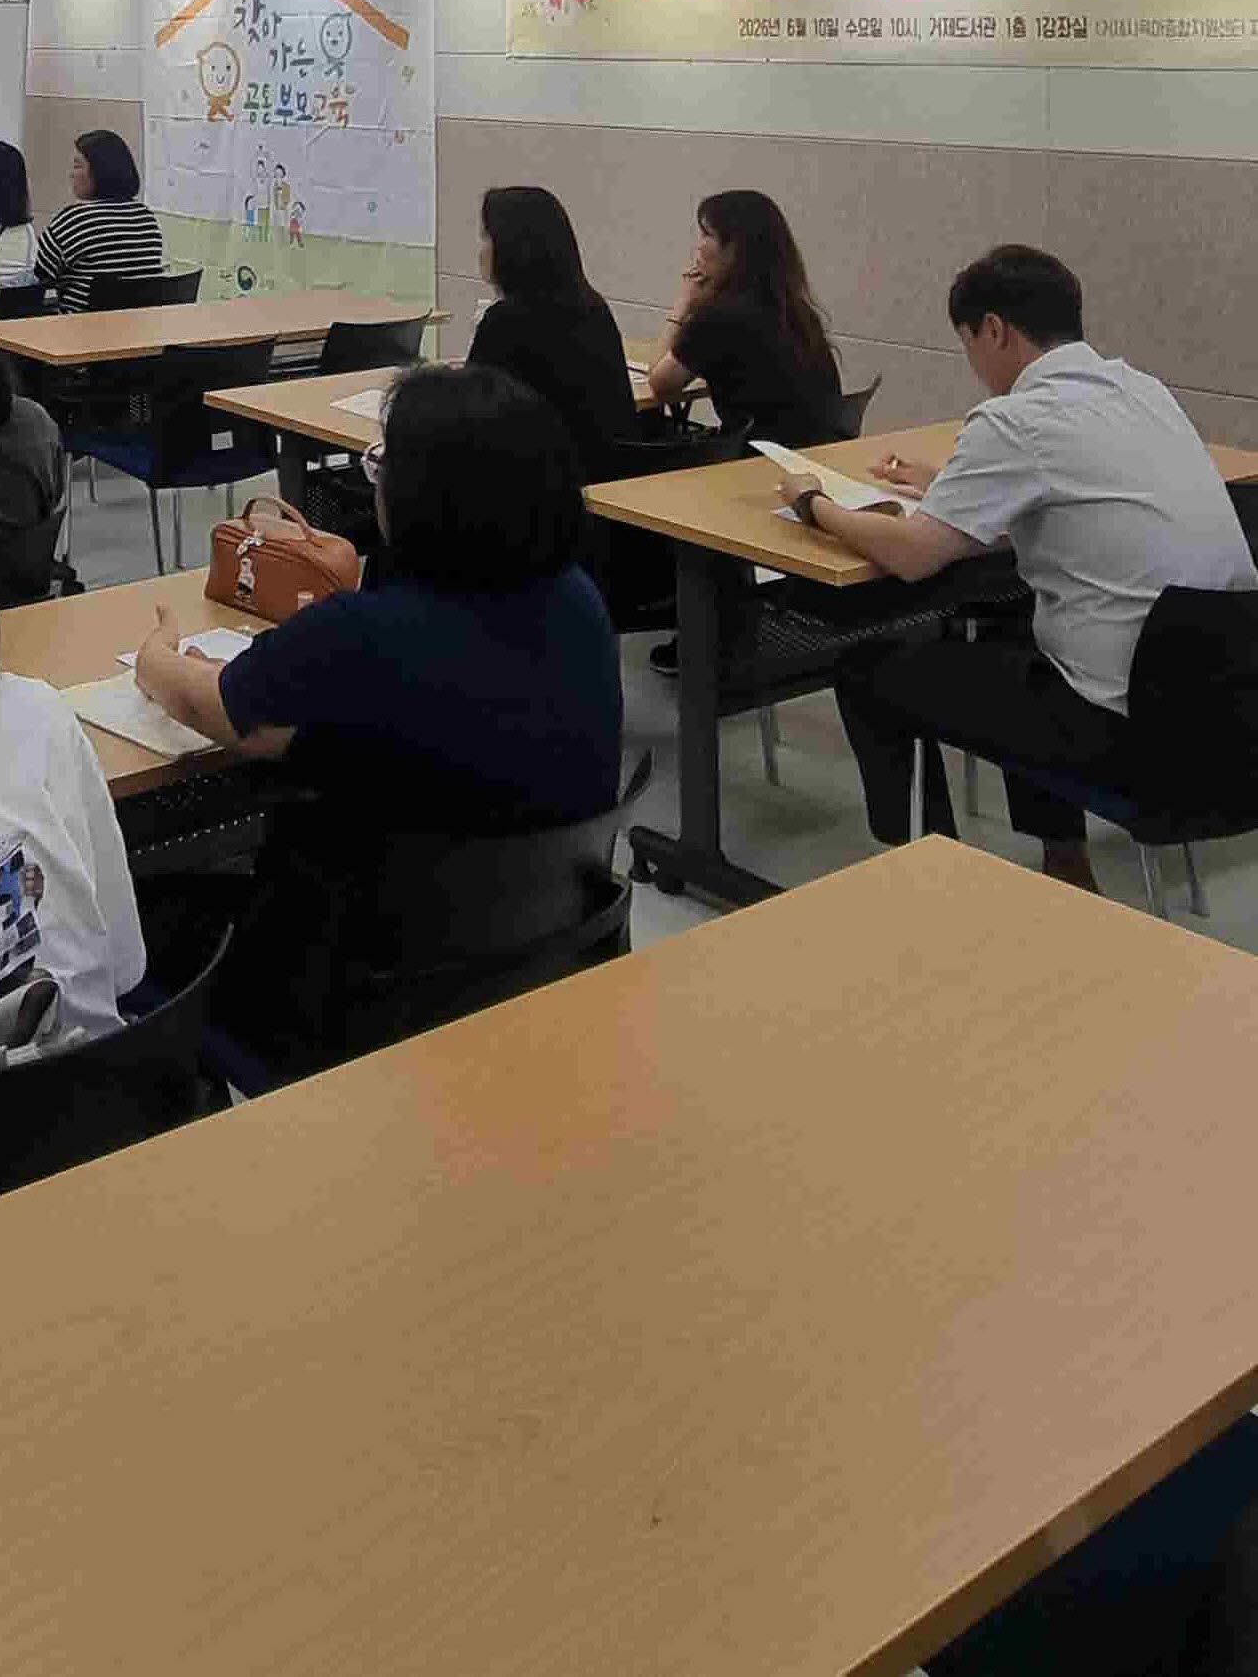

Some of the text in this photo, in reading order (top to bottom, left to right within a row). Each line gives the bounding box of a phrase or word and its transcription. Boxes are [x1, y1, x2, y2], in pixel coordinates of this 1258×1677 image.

[739, 17, 780, 38] 2026년
[787, 17, 807, 38] 6월
[814, 17, 839, 38] 10일
[845, 17, 883, 39] 수요일
[929, 16, 997, 39] 거제도서관
[1006, 16, 1027, 39] 1층
[1035, 15, 1088, 39] 1강좌실
[269, 39, 315, 78] 가는
